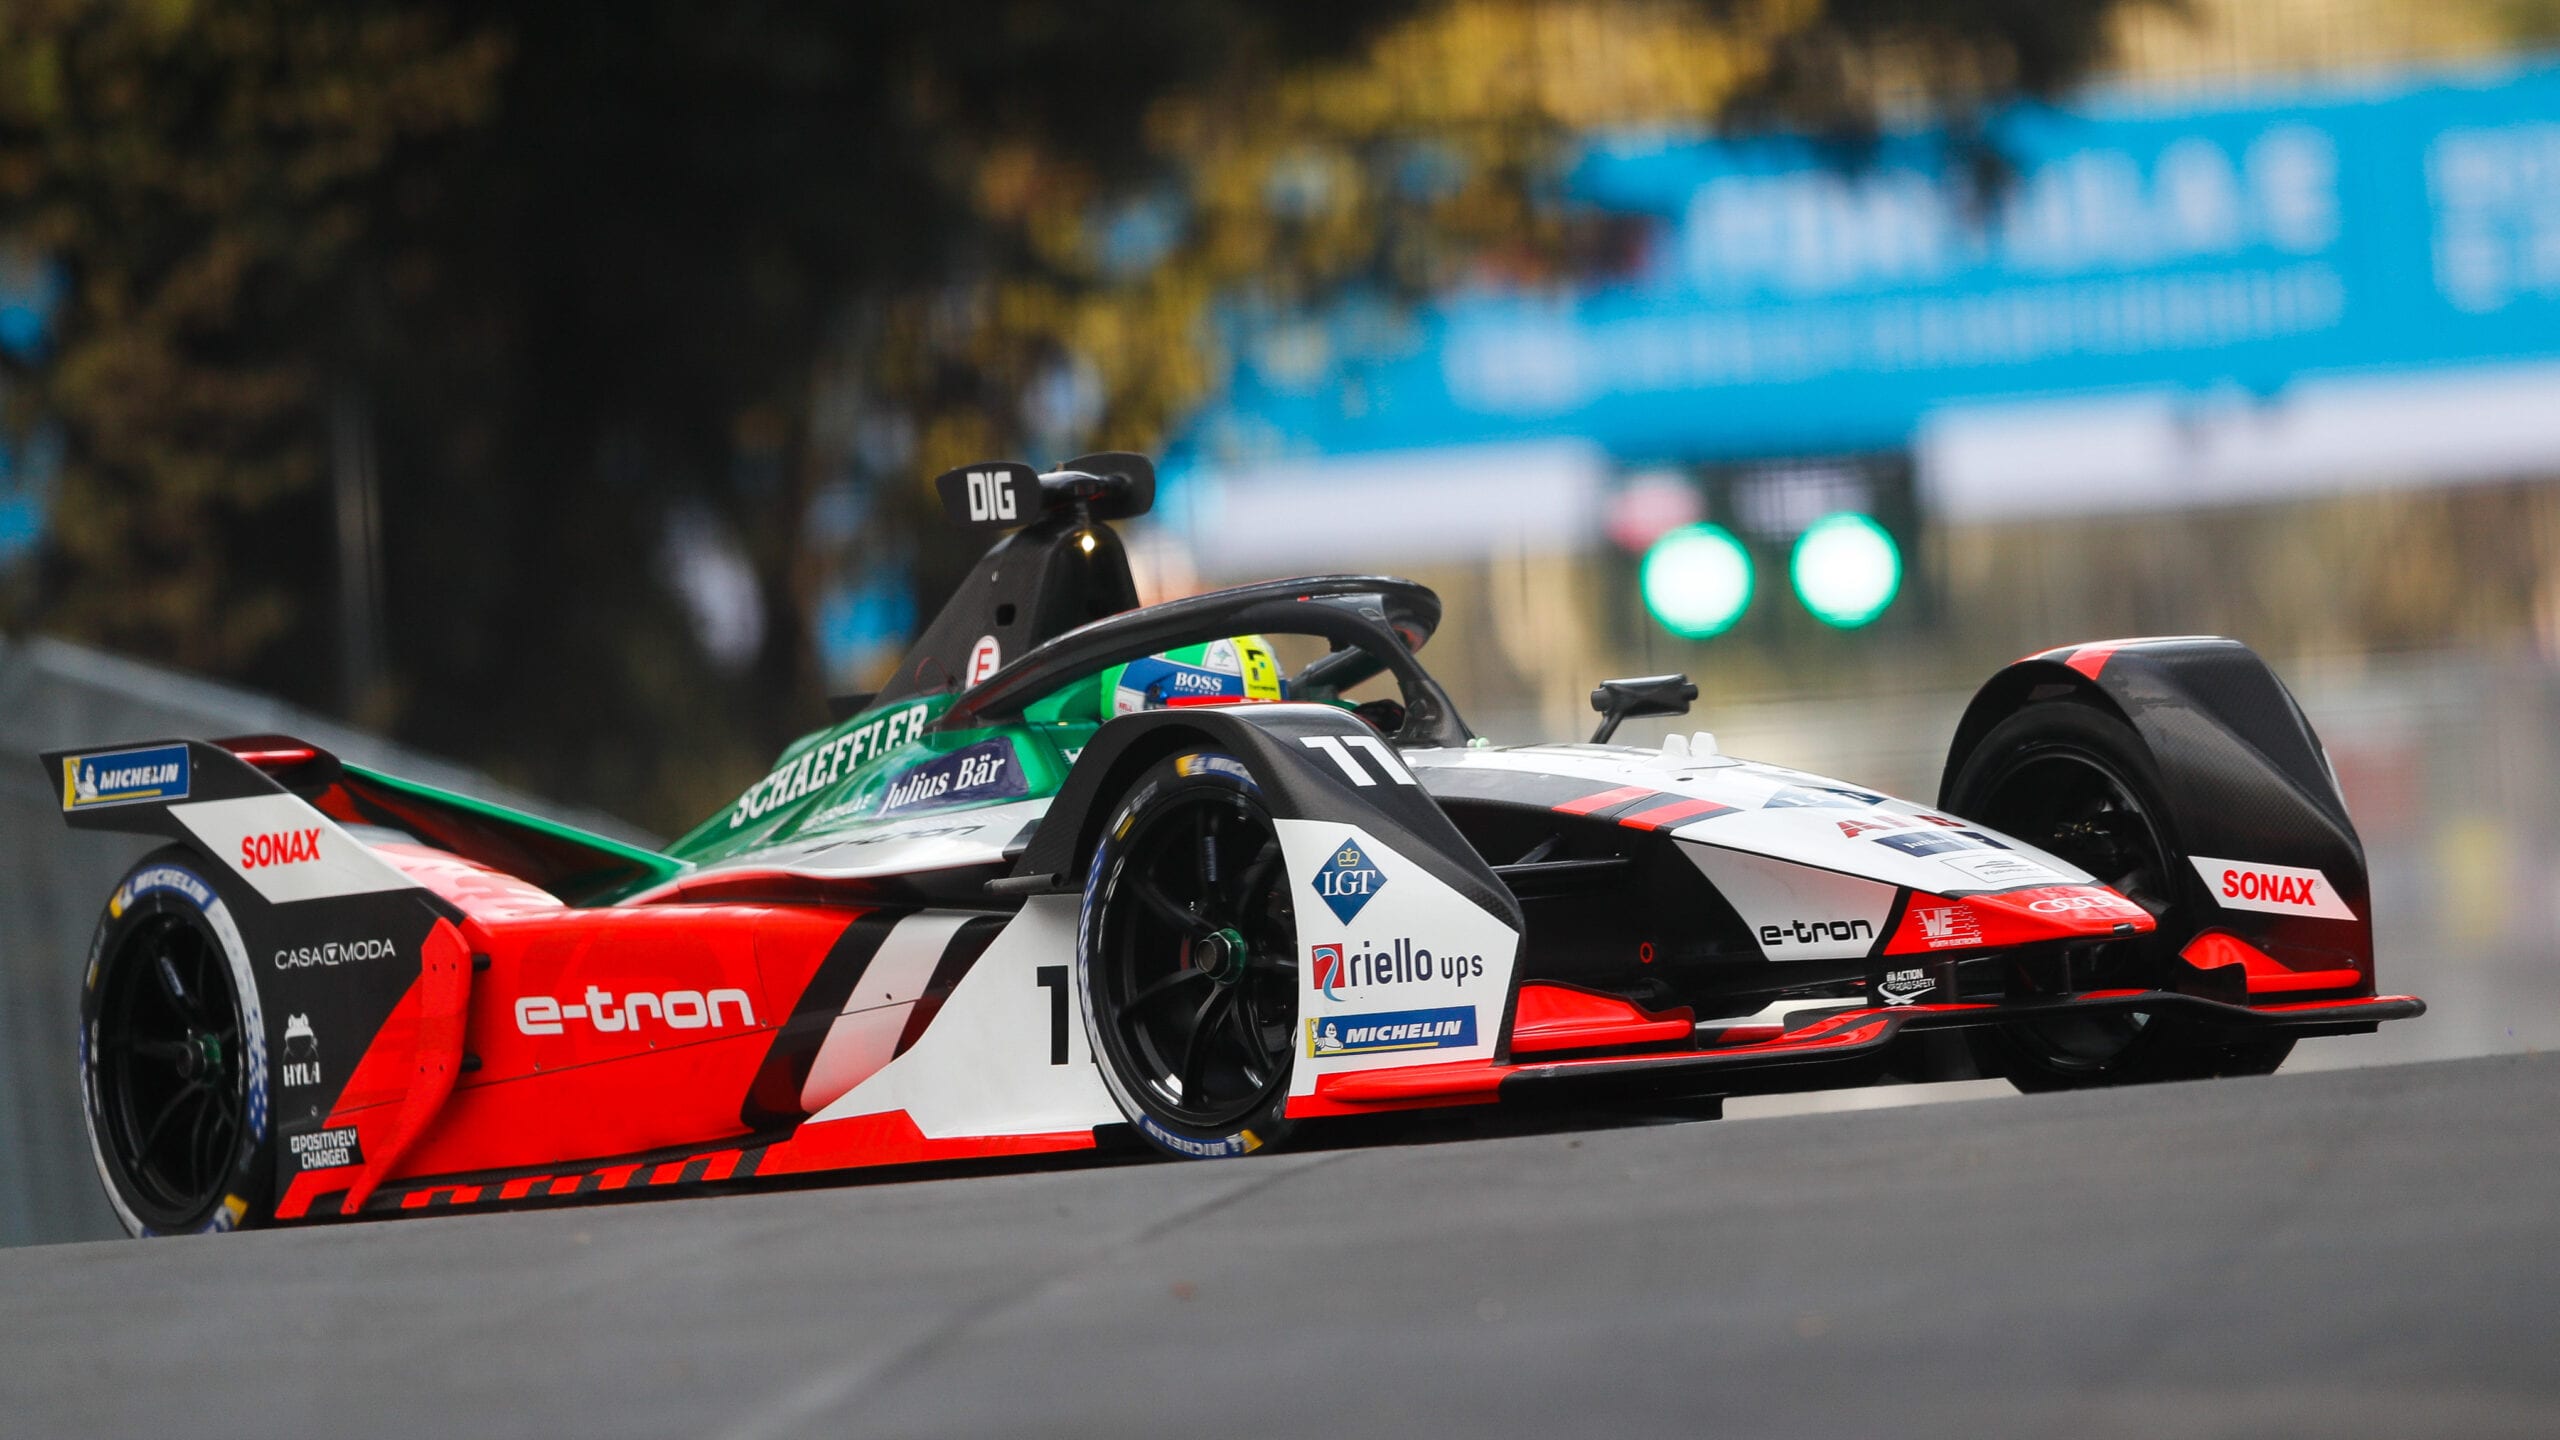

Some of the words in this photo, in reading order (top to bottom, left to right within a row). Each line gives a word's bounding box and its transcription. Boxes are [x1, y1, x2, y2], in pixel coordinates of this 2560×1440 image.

[966, 471, 1017, 521] DIG
[1175, 672, 1223, 692] BOSS
[729, 704, 929, 829] SCHAEFFLER
[1299, 736, 1418, 787] 11
[99, 763, 180, 791] MICHELIN
[880, 770, 949, 818] Julius
[953, 753, 1005, 792] Bär
[241, 828, 321, 869] SONAX
[133, 868, 209, 905] MICHELIN
[1322, 869, 1377, 897] LGT
[2222, 869, 2316, 907] SONAX
[1759, 919, 1874, 947] e-tron
[1918, 908, 1953, 937] WE
[1350, 938, 1433, 987] riello
[1441, 955, 1483, 987] ups
[1896, 968, 1923, 981] ACTION
[1912, 978, 1936, 990] SAFETY
[515, 985, 756, 1036] e-tron
[1345, 1020, 1462, 1044] MICHELIN
[283, 1062, 321, 1087] HYLA
[300, 1128, 357, 1151] POSITIVELY
[1144, 1121, 1228, 1157] MICHELIN
[302, 1148, 350, 1170] CHARGED
